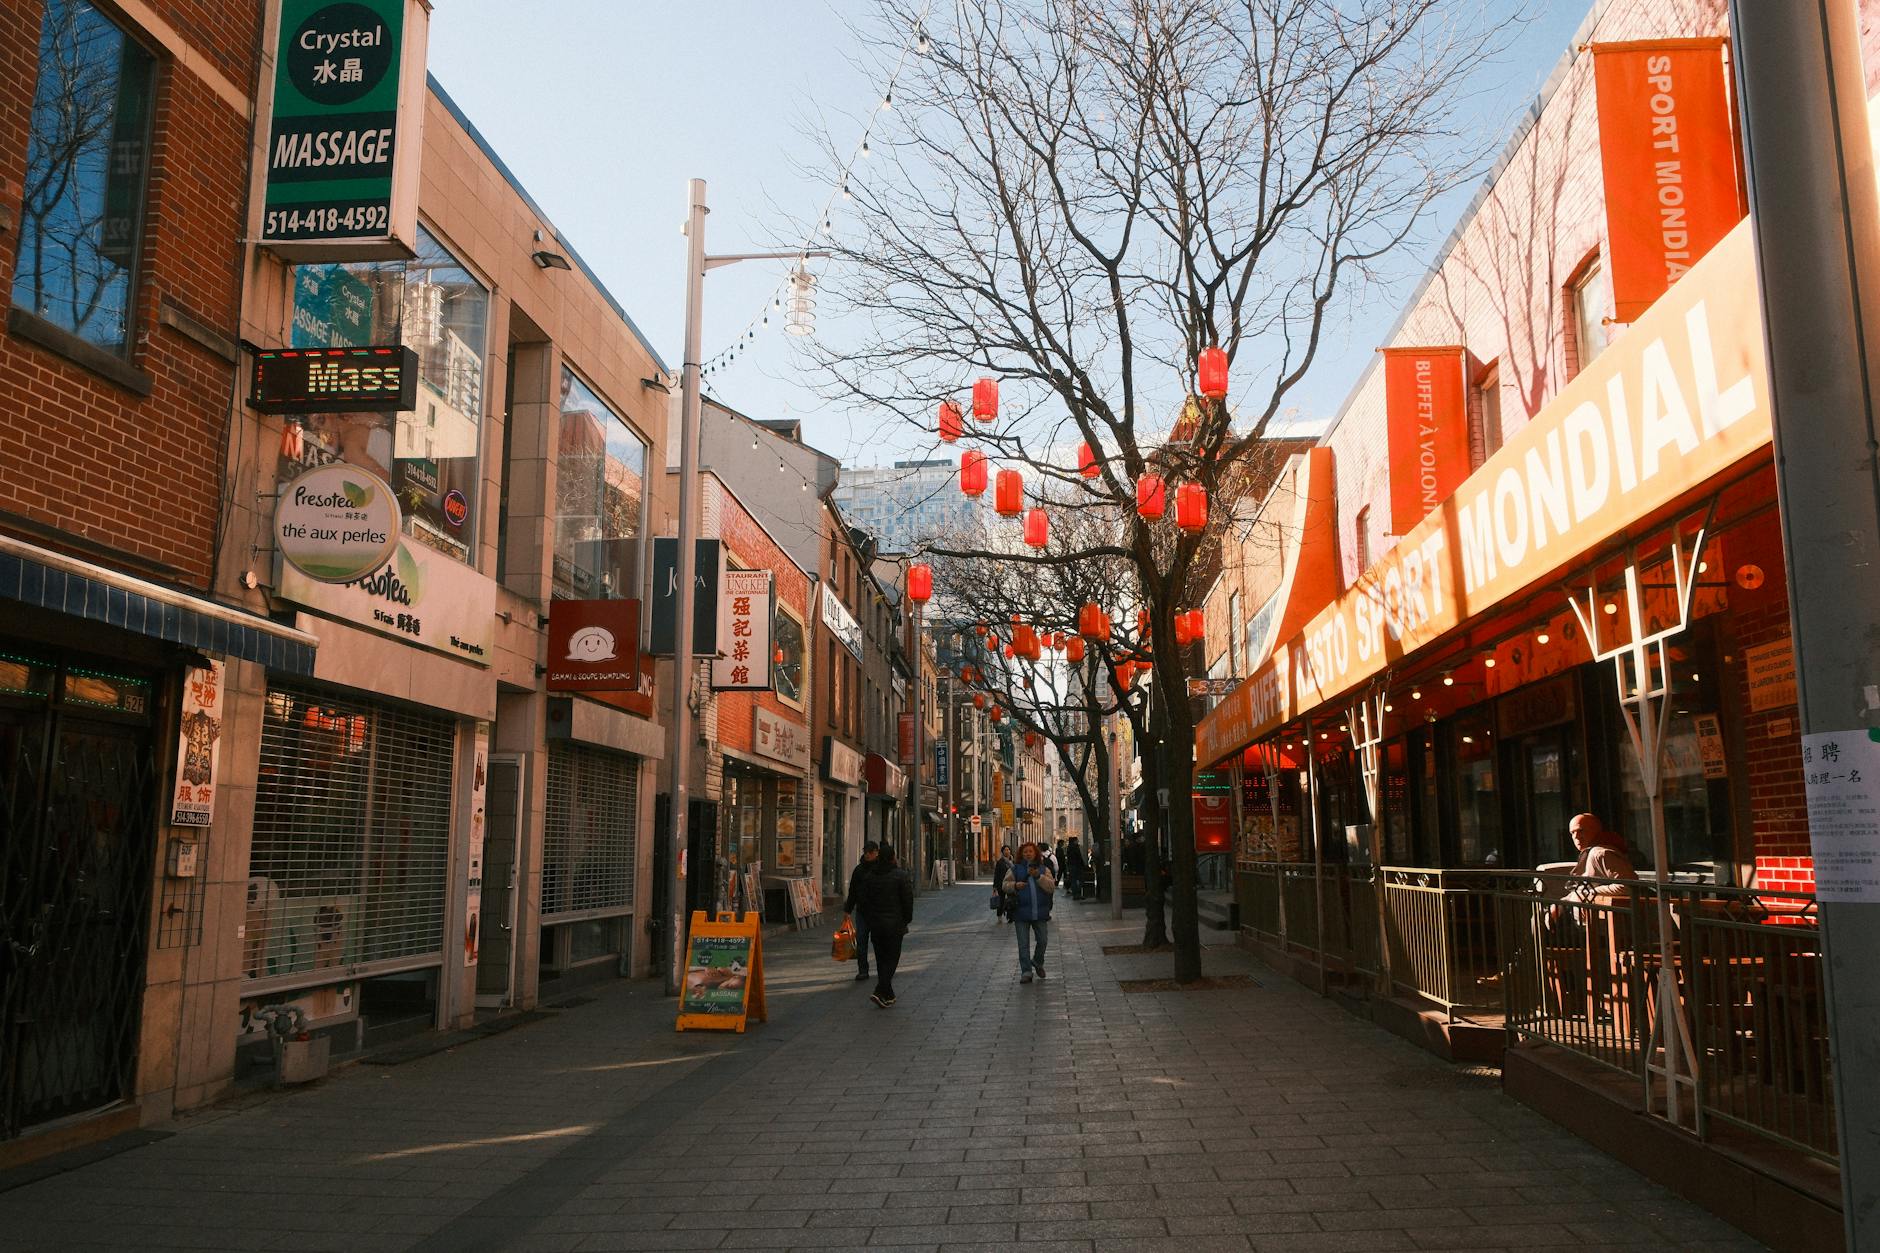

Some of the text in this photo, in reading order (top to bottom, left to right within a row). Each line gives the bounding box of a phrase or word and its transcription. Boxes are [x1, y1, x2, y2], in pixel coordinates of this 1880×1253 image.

[301, 25, 381, 59] Crystal
[312, 58, 363, 85] 水晶
[273, 128, 392, 168] MASSAGE
[1647, 56, 1691, 291] SPORT MONDIA
[266, 206, 387, 235] 514-418-4592
[309, 363, 399, 392] Mass
[1415, 360, 1438, 517] BUFFET À VOLONT
[295, 486, 356, 508] Presotea
[1249, 299, 1756, 728] BUFFET RESTO SPORT MONDIAL
[283, 523, 386, 545] thé aux perles
[750, 579, 768, 590] KEE
[599, 672, 630, 680] DUMPLING
